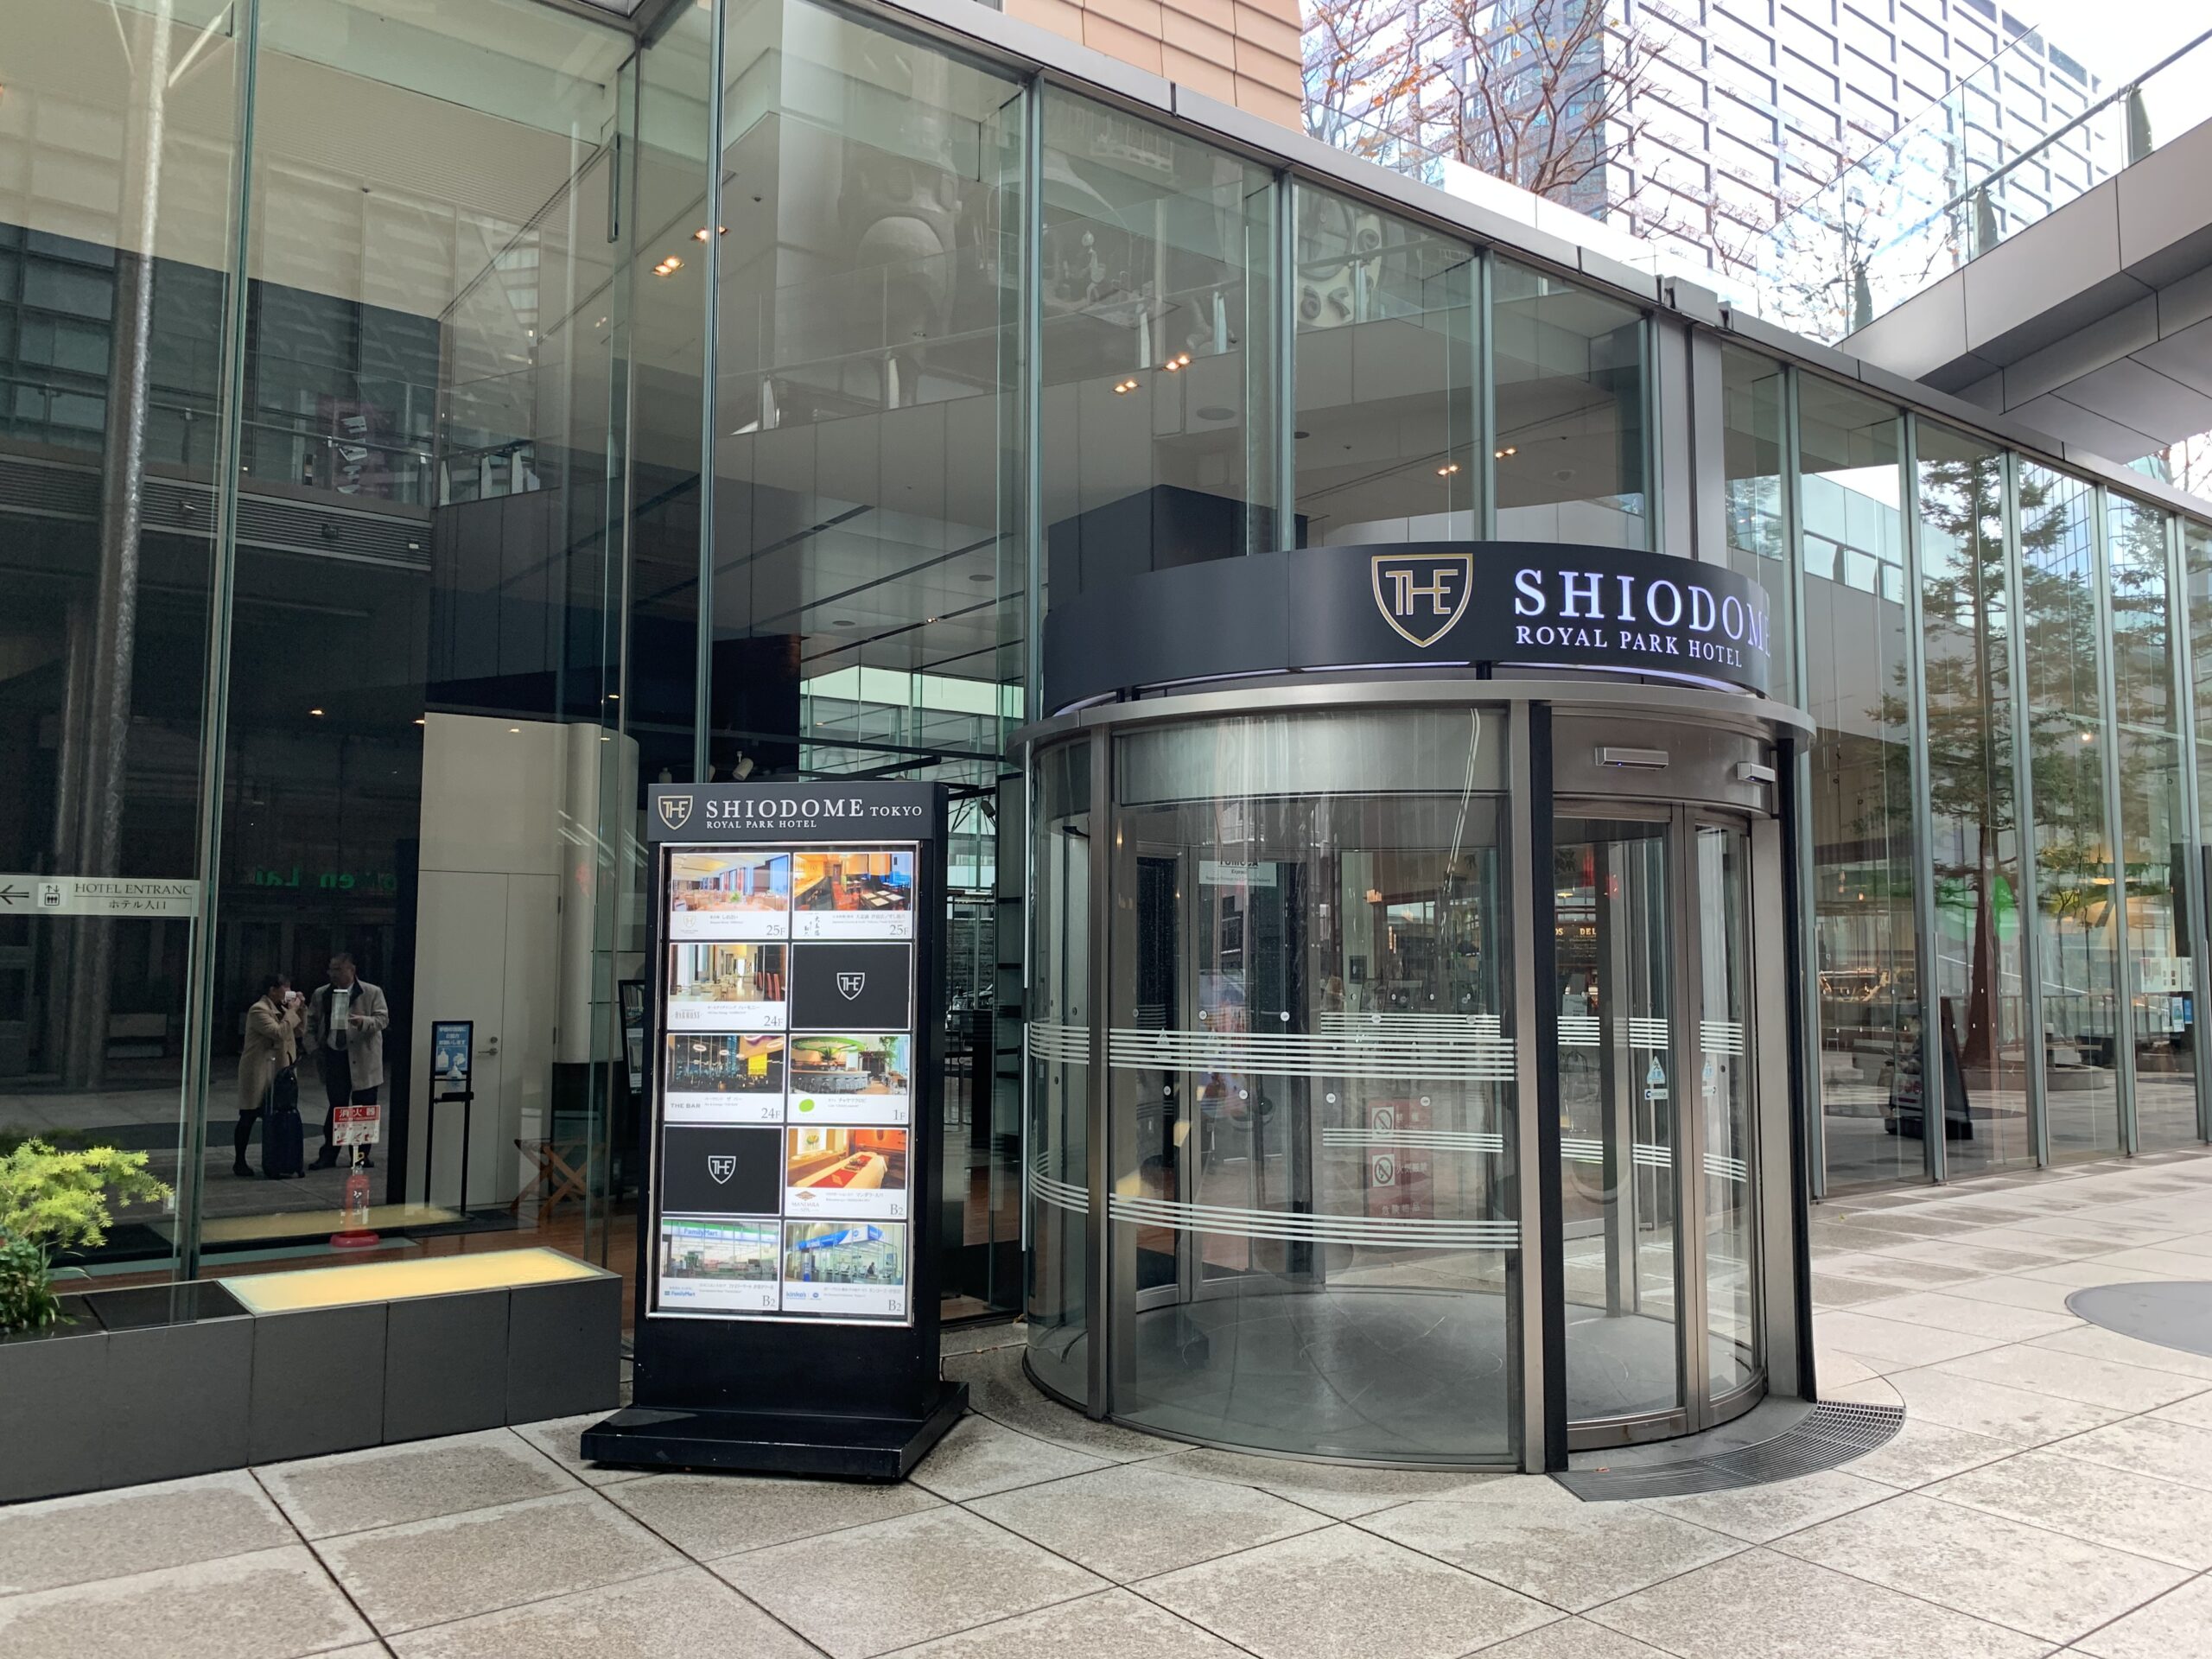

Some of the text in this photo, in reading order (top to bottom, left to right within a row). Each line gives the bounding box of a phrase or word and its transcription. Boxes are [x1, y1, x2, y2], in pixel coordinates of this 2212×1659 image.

[1385, 569, 1459, 615] THE
[1516, 626, 1742, 668] ROYAL PARK HOTEL
[663, 800, 689, 818] THE
[706, 798, 923, 818] SHIODOME TOKYO
[75, 883, 122, 893] HOTEL
[109, 899, 167, 910] ホテル入口
[766, 925, 786, 936] 25F
[889, 925, 909, 937] 25F
[841, 976, 861, 991] THE
[764, 1015, 784, 1027] 24F
[761, 1107, 781, 1119] 24F
[893, 1109, 906, 1121] 1F
[712, 1160, 732, 1175] THE
[890, 1204, 904, 1216] B2
[683, 1228, 718, 1237] FamilyMart
[762, 1295, 776, 1307] B2
[888, 1300, 902, 1312] B2
